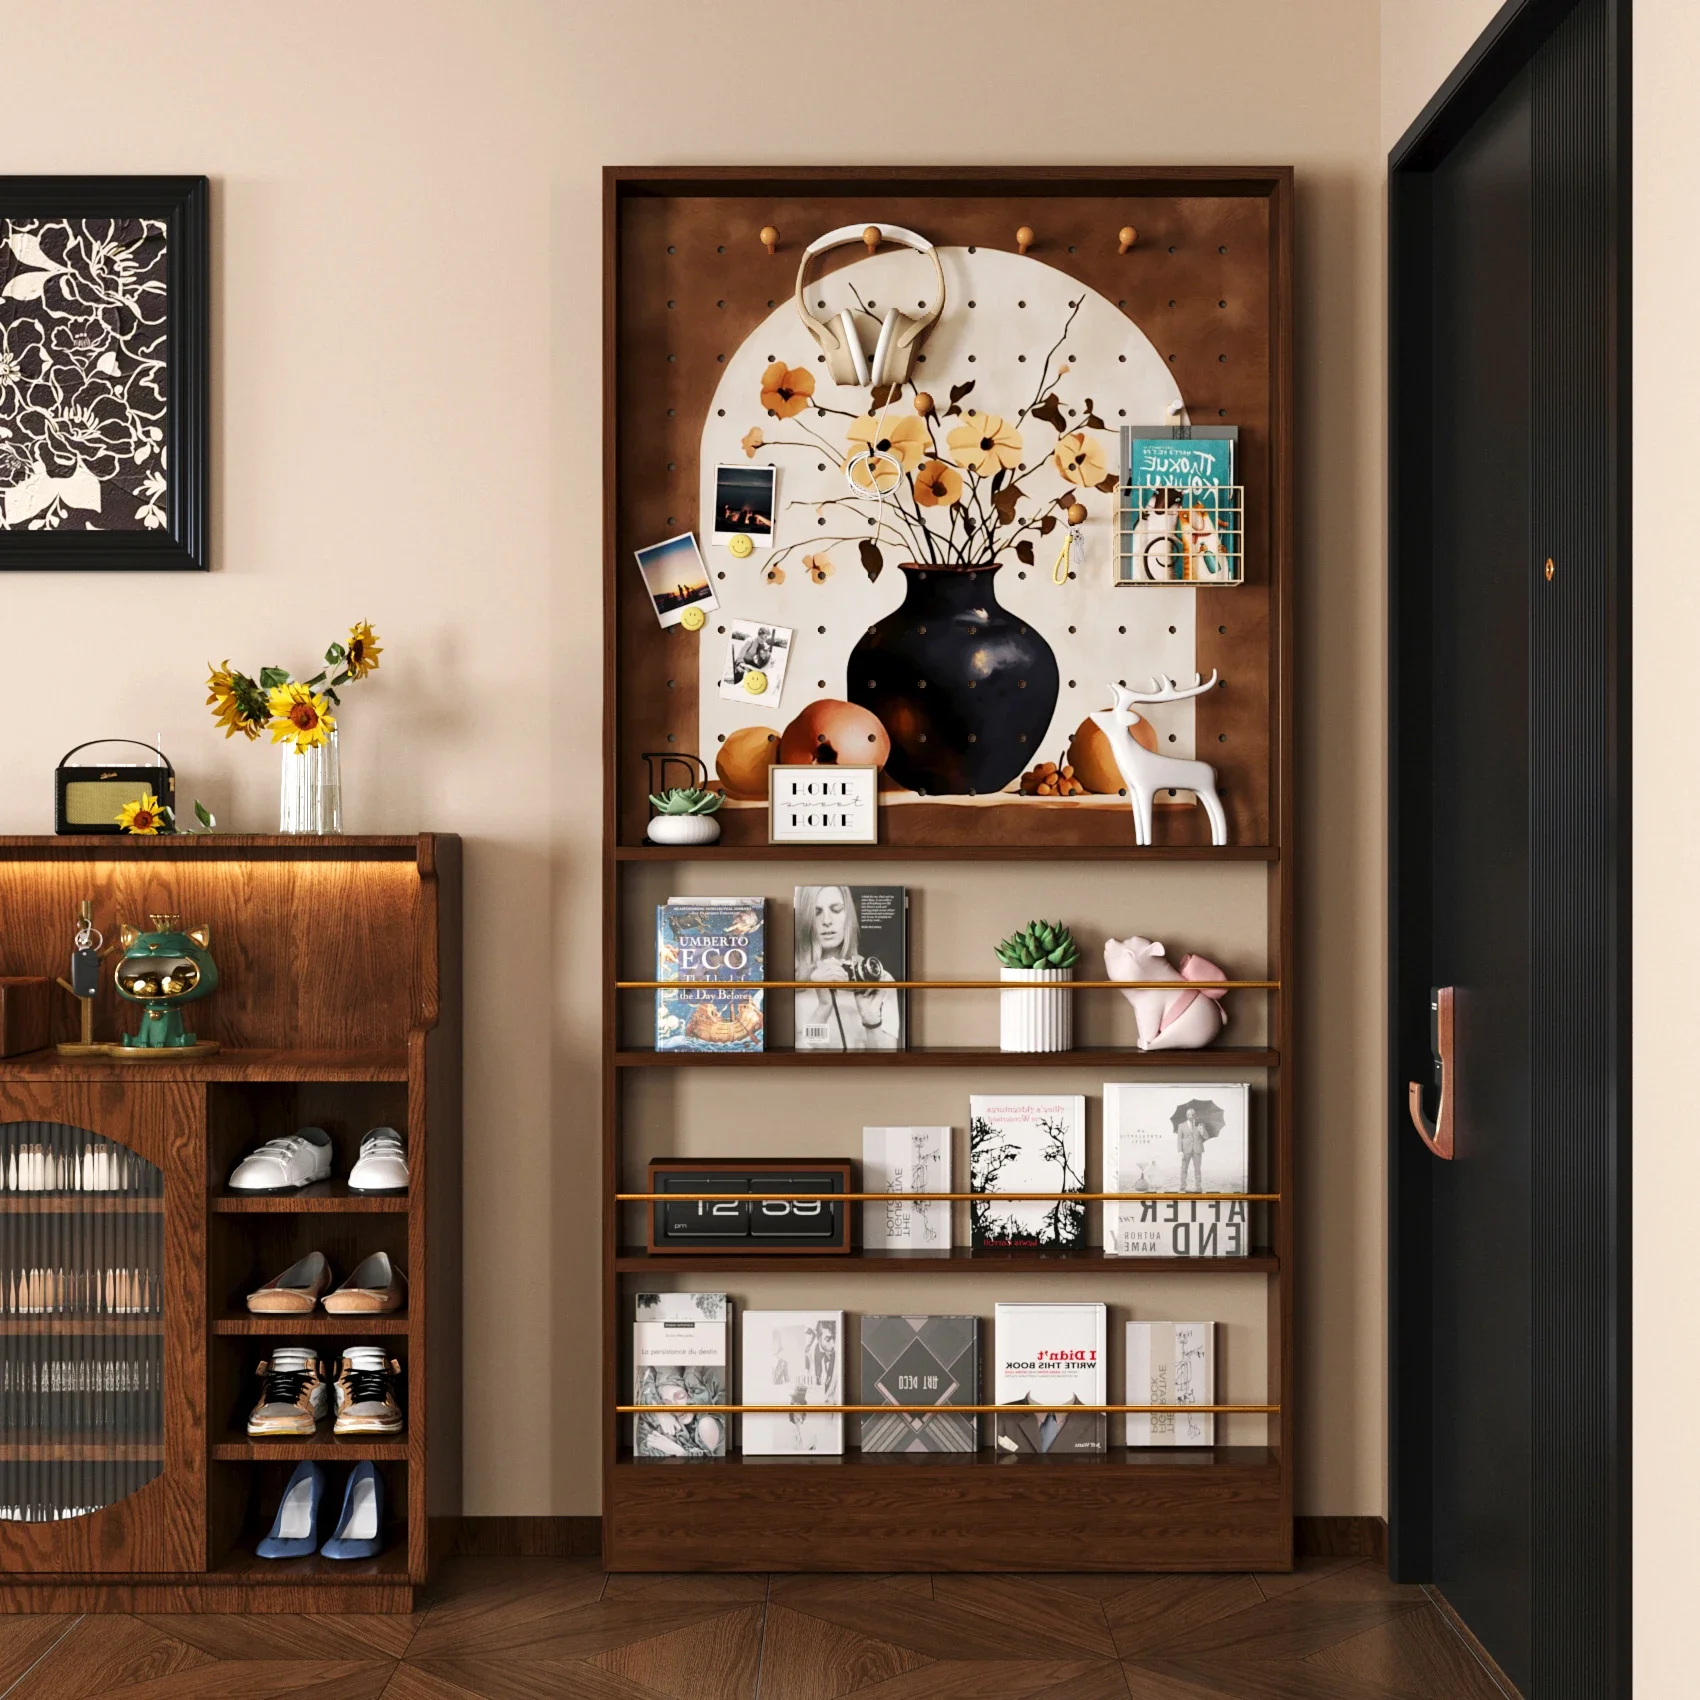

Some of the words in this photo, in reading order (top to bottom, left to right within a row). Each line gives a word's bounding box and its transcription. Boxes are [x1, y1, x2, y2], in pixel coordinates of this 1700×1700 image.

[790, 782, 854, 795] HOME
[781, 795, 864, 807] sweet
[790, 813, 854, 827] HOME
[679, 935, 749, 947] UMBERTO
[679, 948, 748, 970] ECO
[680, 989, 694, 1000] the
[695, 989, 716, 1003] Day
[717, 989, 748, 1000] Before
[898, 1375, 918, 1390] DECO
[922, 1375, 939, 1390] ART
